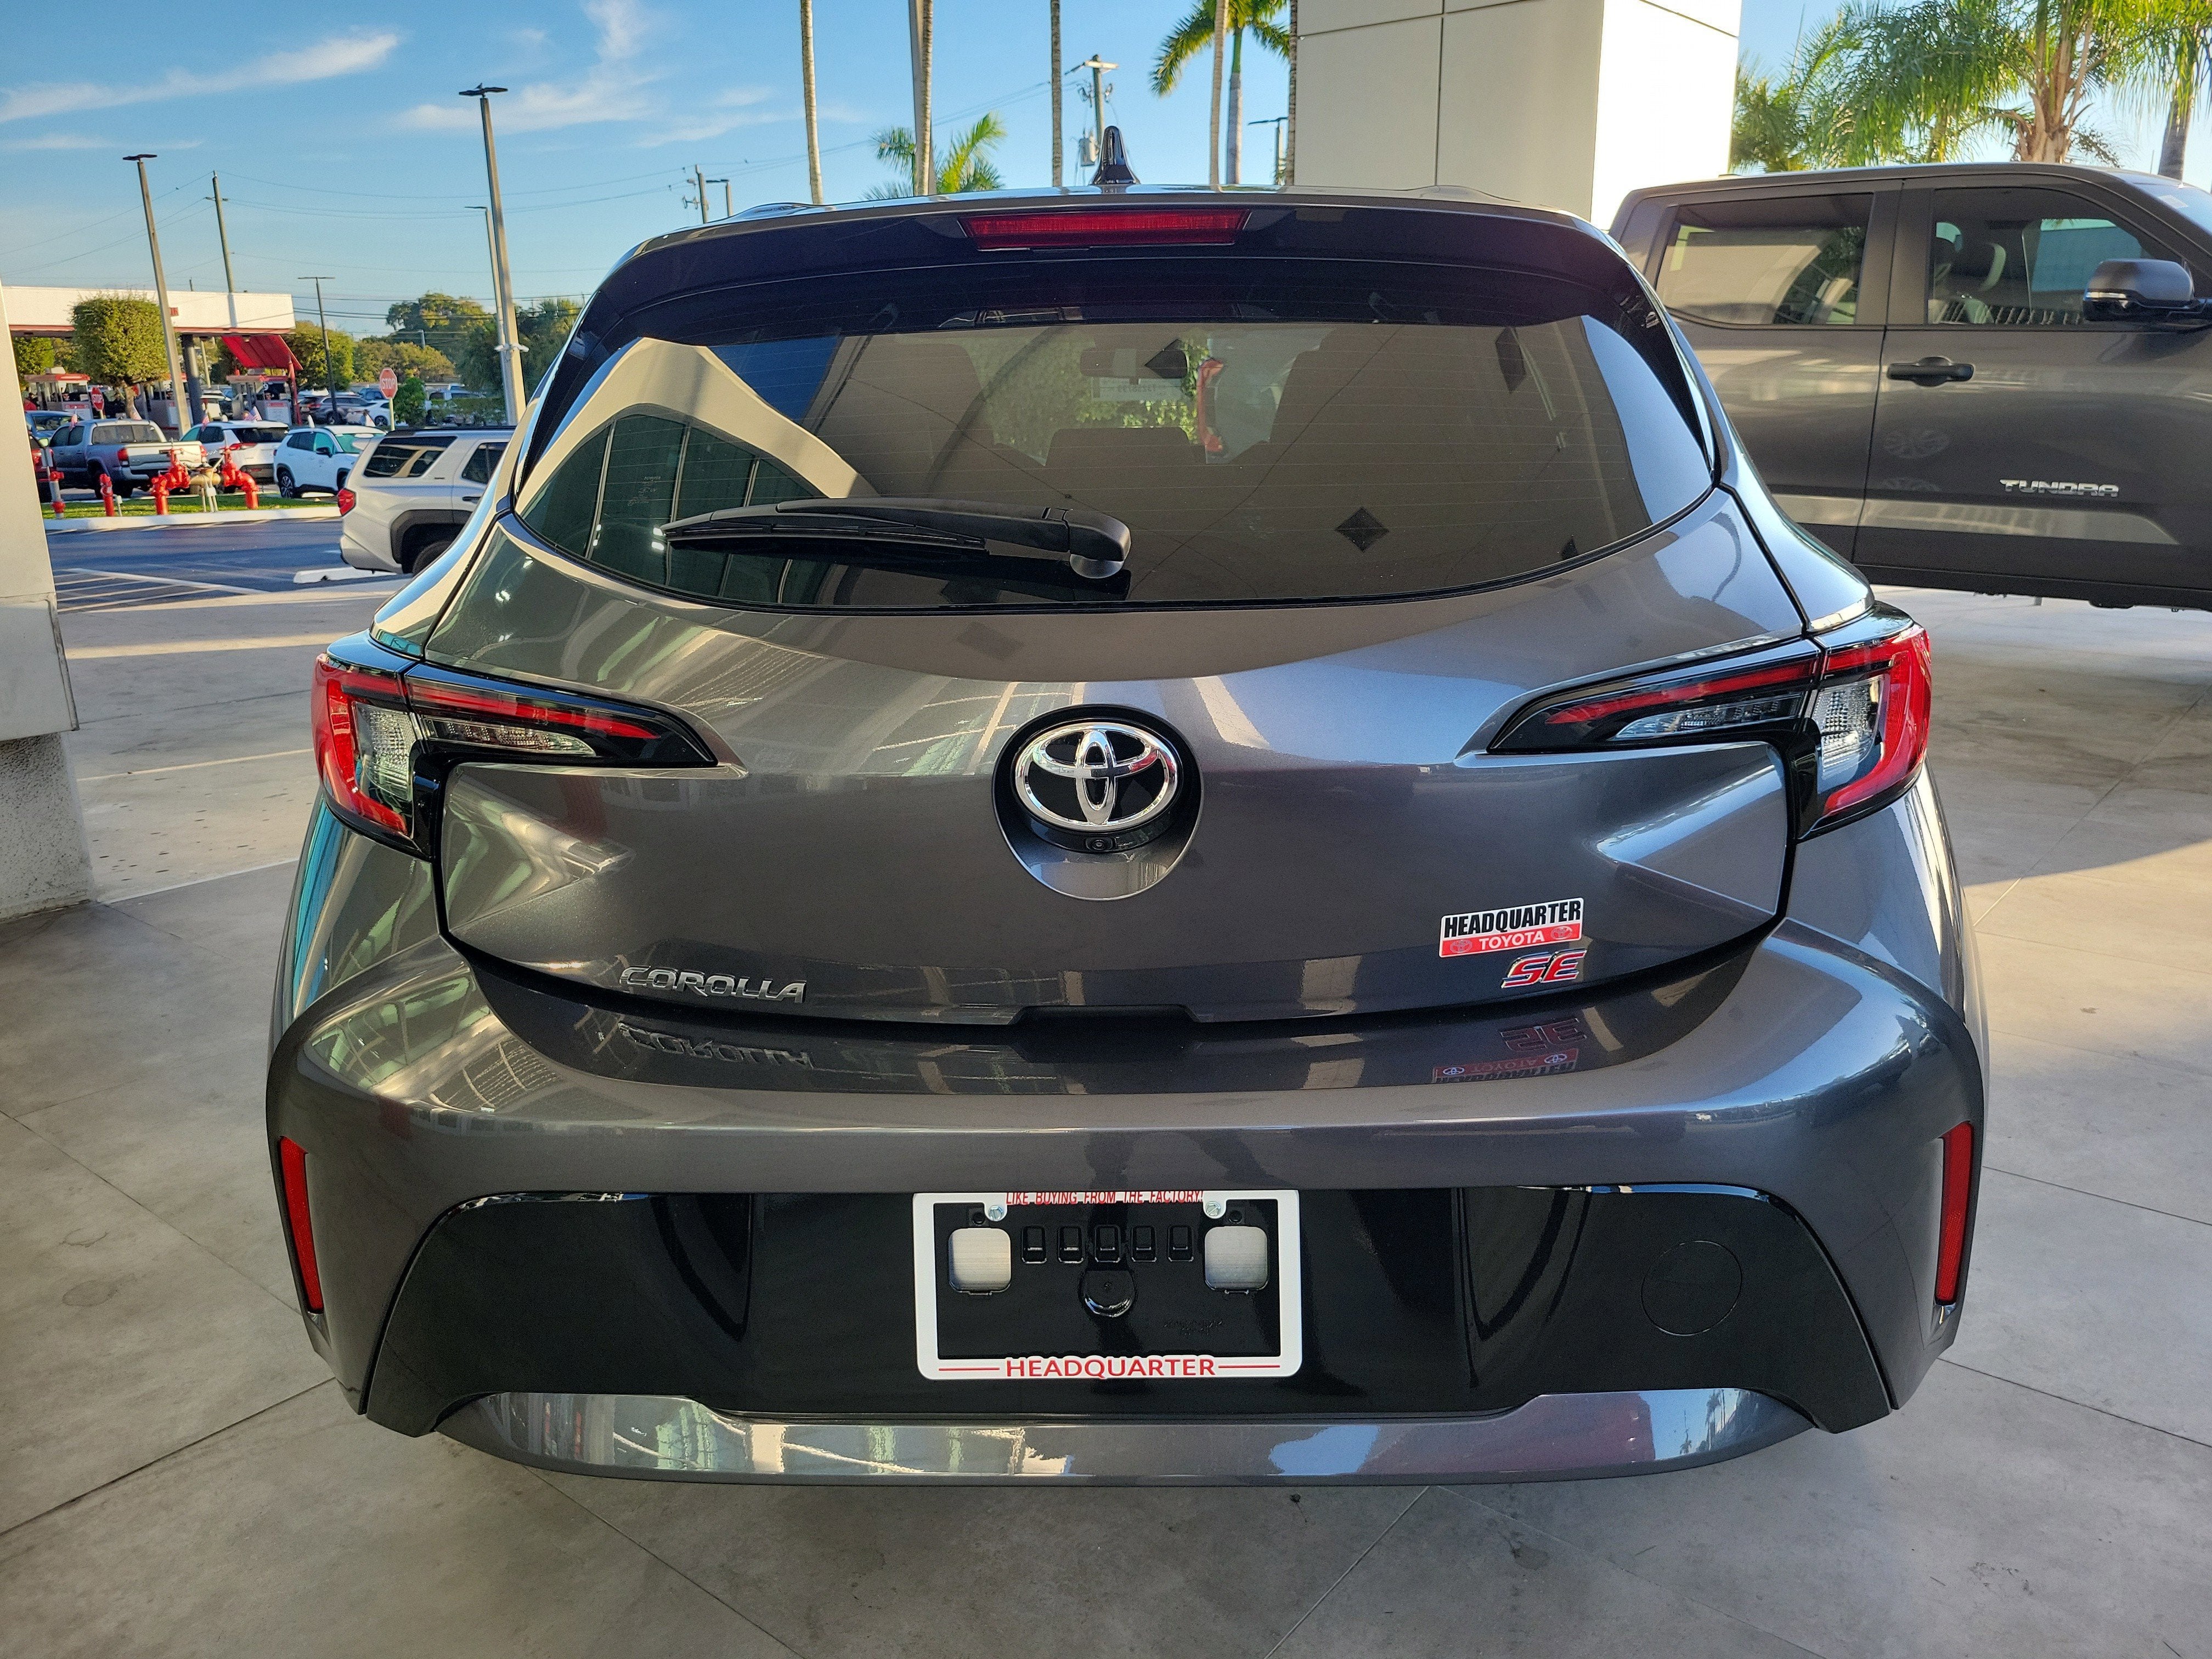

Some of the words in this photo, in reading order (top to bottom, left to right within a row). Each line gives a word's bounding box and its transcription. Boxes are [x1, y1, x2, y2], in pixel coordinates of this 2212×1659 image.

[382, 377, 396, 390] STOP
[92, 394, 103, 404] STOP
[2000, 478, 2119, 498] TUNDRA
[1443, 900, 1582, 938] HEADQUARTER
[1479, 930, 1545, 951] TOYOTA
[1501, 948, 1587, 989] SE
[619, 965, 807, 1003] COROLLA
[1006, 1192, 1029, 1205] LIKE
[1035, 1192, 1077, 1205] BUYING
[1083, 1192, 1116, 1204] FROM
[1123, 1191, 1144, 1204] THE
[1149, 1190, 1204, 1204] FACTORY!
[1006, 1358, 1216, 1379] HEADQUARTER
